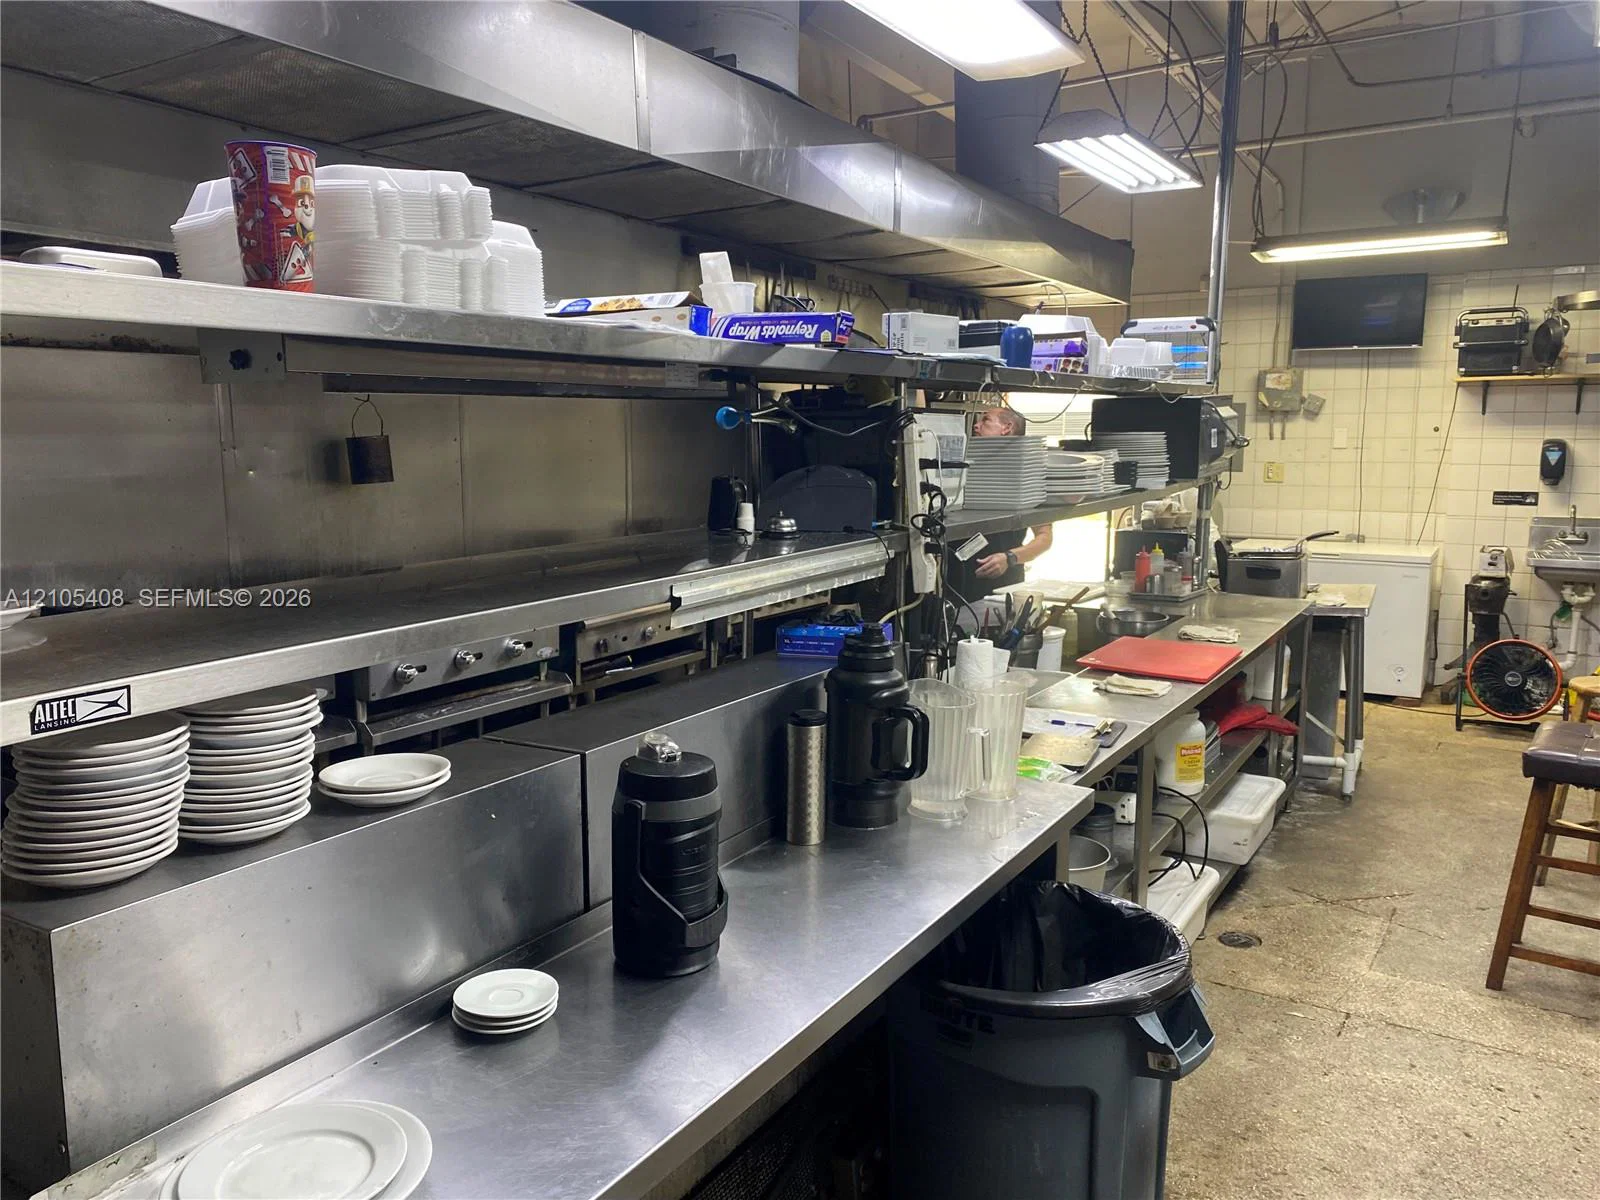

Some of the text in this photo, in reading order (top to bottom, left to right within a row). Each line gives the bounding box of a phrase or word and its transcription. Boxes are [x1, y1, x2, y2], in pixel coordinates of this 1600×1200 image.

[729, 322, 761, 341] Wrap
[761, 320, 819, 339] Reynolds
[34, 698, 76, 724] ALTEC
[34, 718, 76, 731] LANSING
